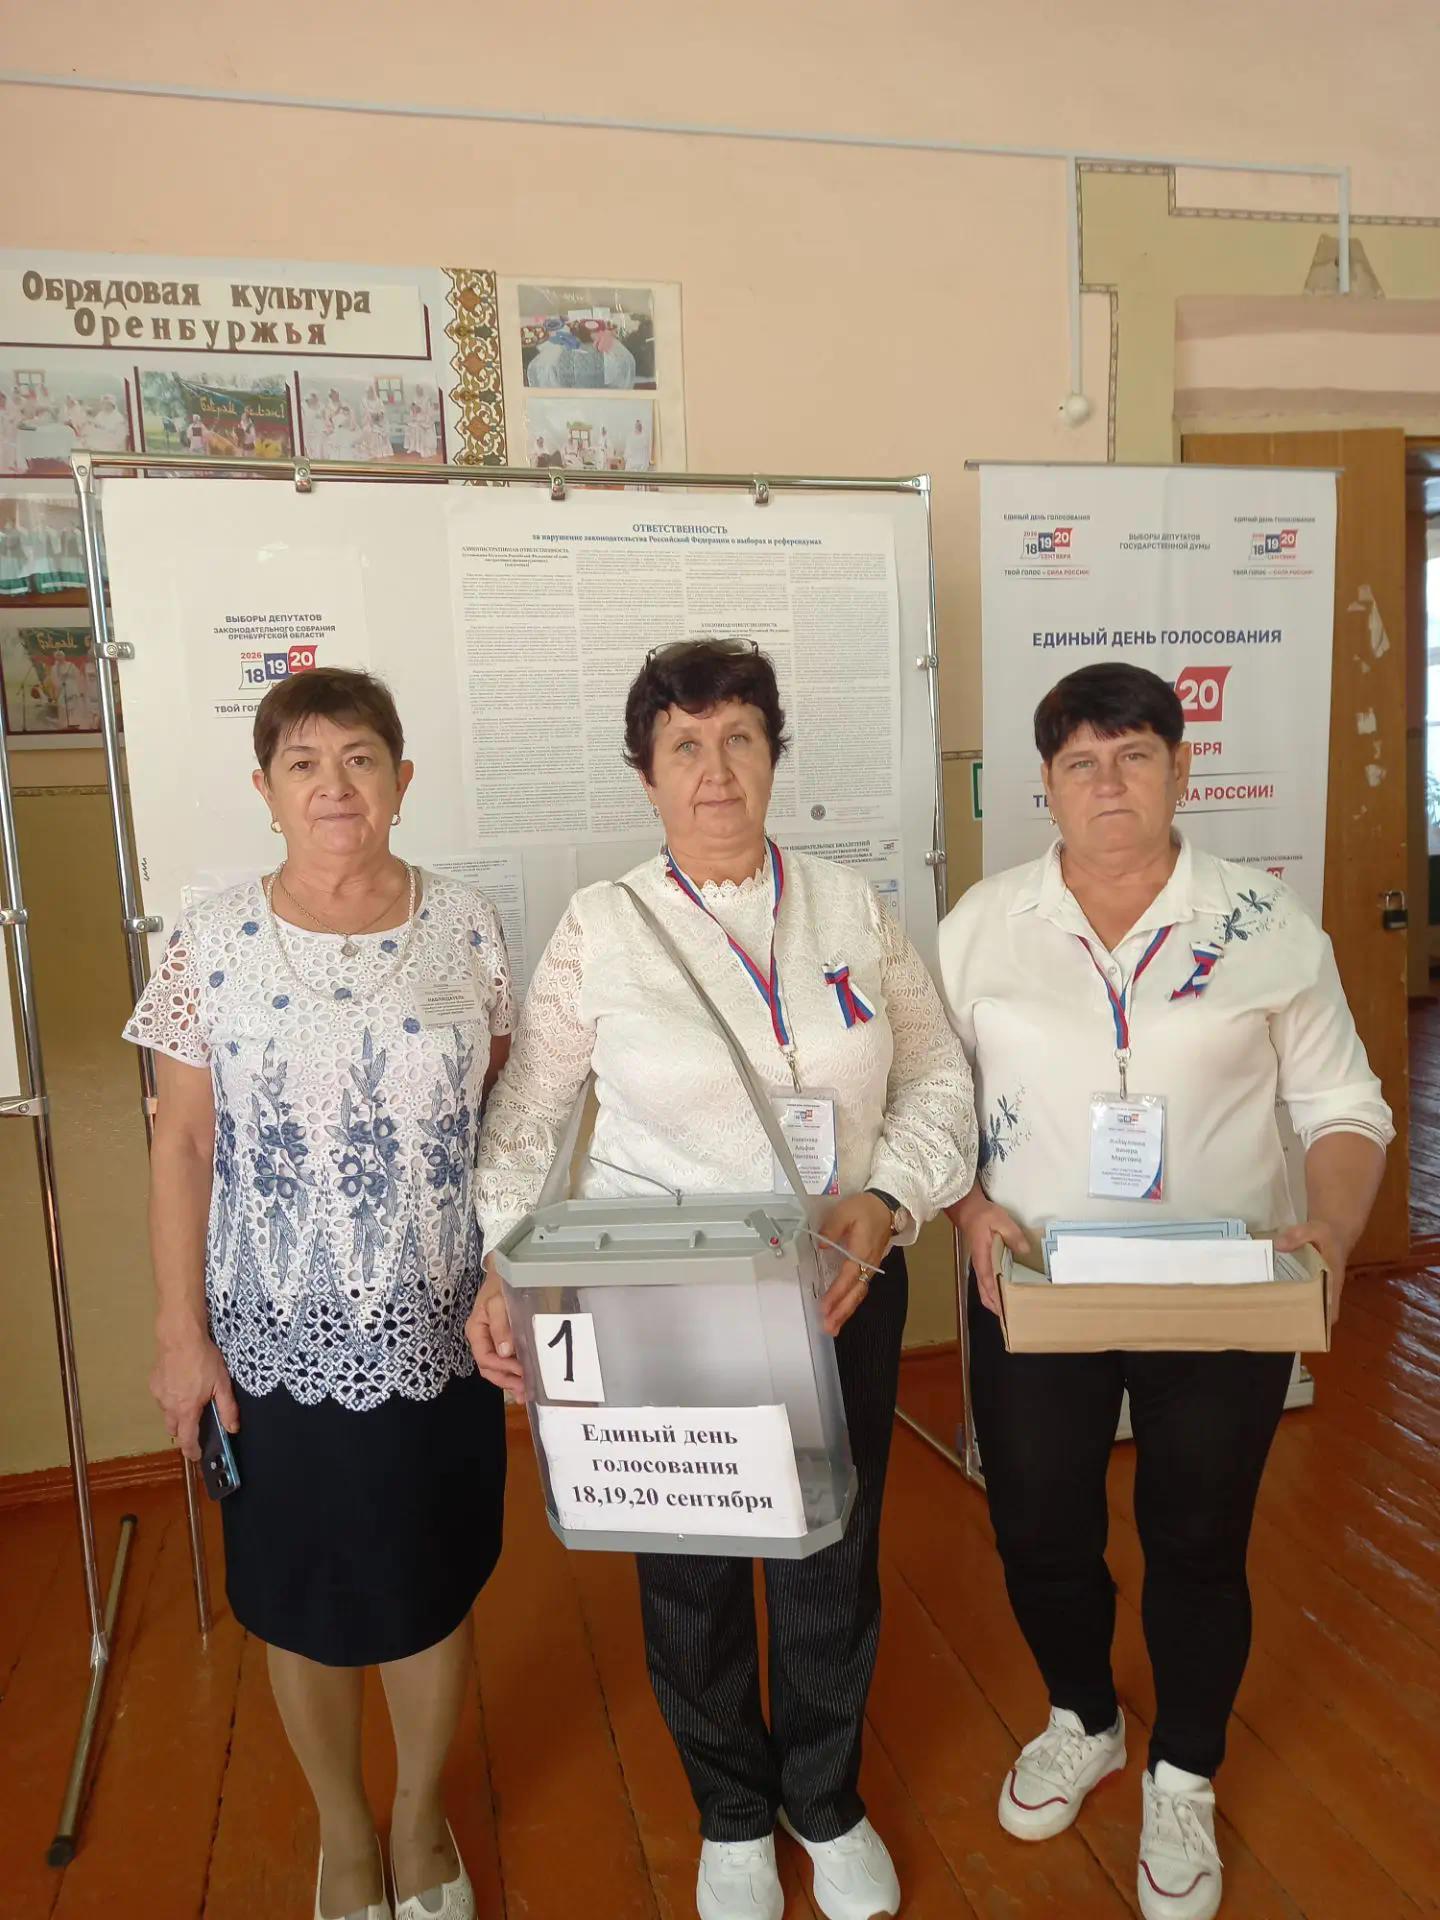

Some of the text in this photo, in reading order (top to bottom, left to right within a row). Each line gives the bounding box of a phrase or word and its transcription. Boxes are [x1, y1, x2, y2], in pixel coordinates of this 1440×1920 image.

[22, 270, 371, 320] Обрядовая культура
[74, 307, 326, 351] Оренбуржья
[632, 523, 728, 535] ОТВЕТСТВЕННОСТЬ
[542, 534, 583, 543] нарушение
[584, 535, 648, 544] законодательства
[649, 535, 690, 544] Российской
[690, 536, 730, 546] Федерации
[736, 537, 767, 545] выборах
[773, 537, 823, 547] референдумах
[1039, 537, 1052, 549] 19
[1055, 532, 1069, 544] 20
[1129, 533, 1200, 542] ВЫБОРЫ ДЕПУТАТОВ
[1266, 537, 1279, 550] 19
[1280, 533, 1295, 545] 20
[1025, 543, 1038, 555] 18
[1120, 541, 1211, 551] ГОСУДАРСТВЕННОЙ ДУМЫ
[1253, 544, 1265, 556] 18
[225, 614, 322, 623] ВЫБОРЫ ДЕПУТАТОВ
[213, 625, 336, 634] ЗАКОНОДАТЕЛЬНОГО СОБРАНИЯ
[228, 631, 325, 640] ОРЕНБУРГСКОЙ ОБЛАСТИ
[1032, 627, 1283, 648] ЕДИНЫЙ ДЕНЬ ГОЛОСОВАНИЯ
[240, 652, 262, 660] 2026
[289, 651, 313, 667] 20
[267, 659, 287, 675] 19
[244, 668, 265, 683] 18
[1179, 678, 1220, 711] 20
[214, 703, 240, 713] ТВОЙ
[1205, 784, 1275, 801] РОССИИ!
[547, 1319, 575, 1383] 1
[581, 1423, 738, 1447] Единый день
[591, 1457, 739, 1476] голосования
[572, 1484, 773, 1513] 18,19,20 сентября
